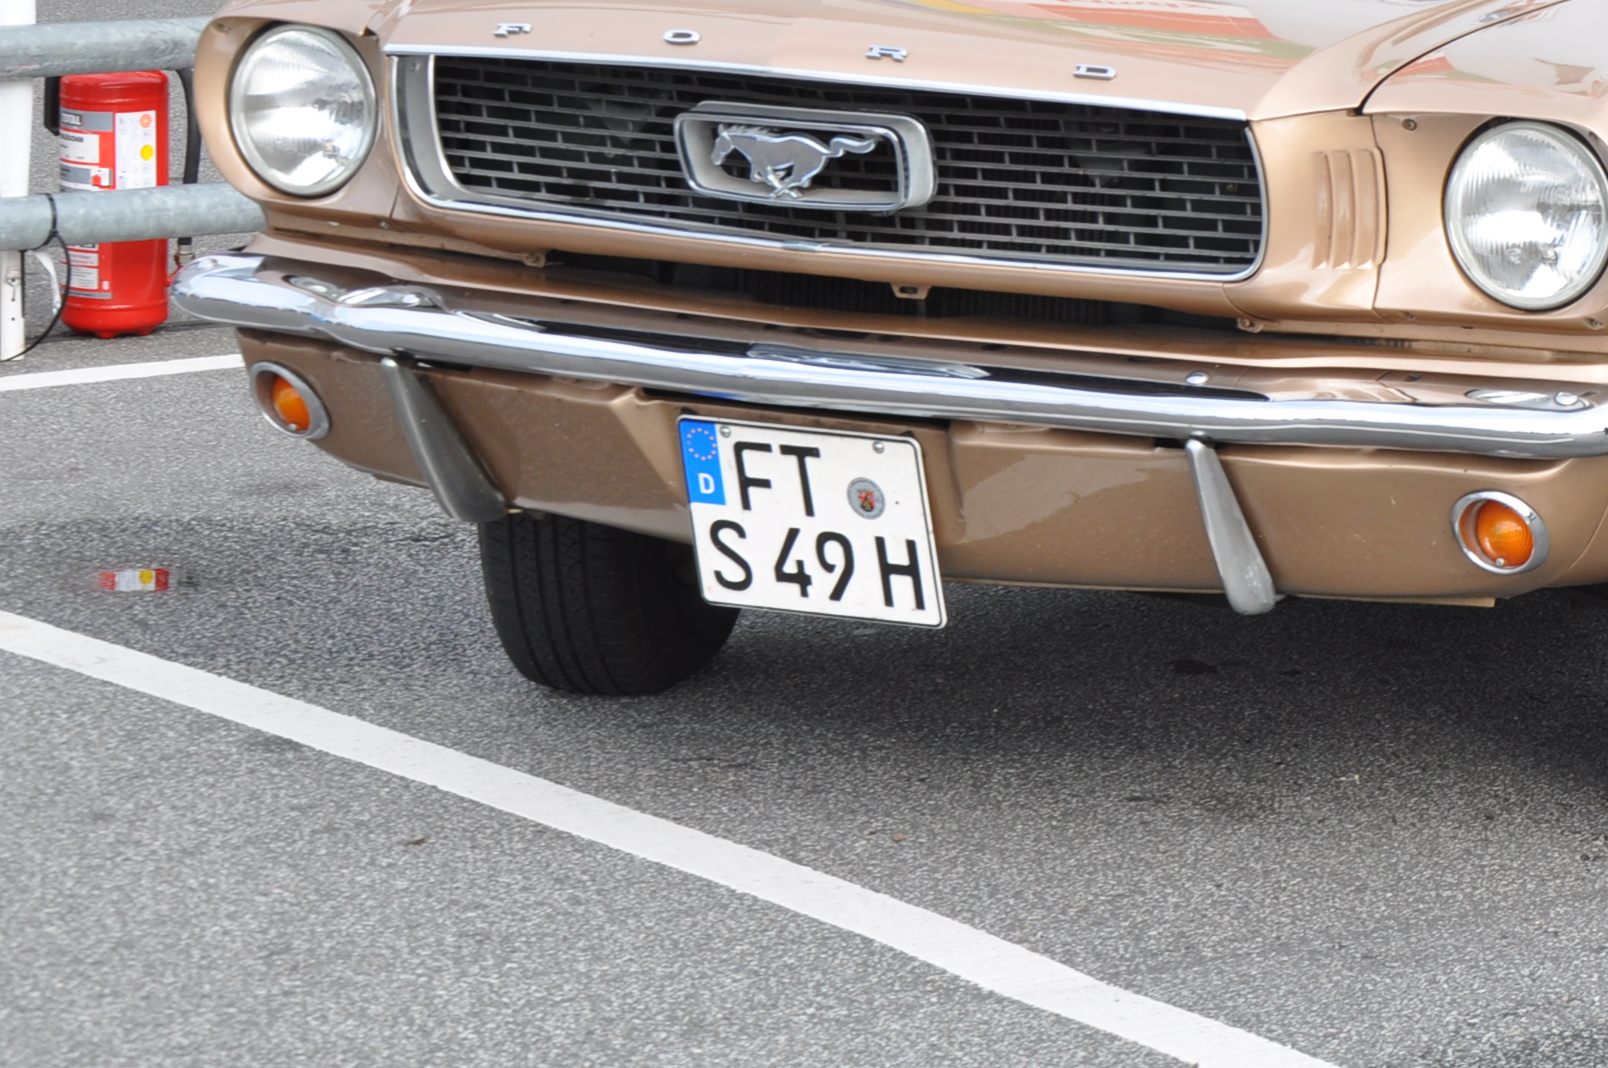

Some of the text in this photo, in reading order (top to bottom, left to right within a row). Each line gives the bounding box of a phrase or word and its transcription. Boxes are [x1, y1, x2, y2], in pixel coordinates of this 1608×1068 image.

[493, 22, 1118, 82] FORD
[697, 472, 715, 494] D
[733, 440, 821, 517] FT
[709, 519, 753, 592] S
